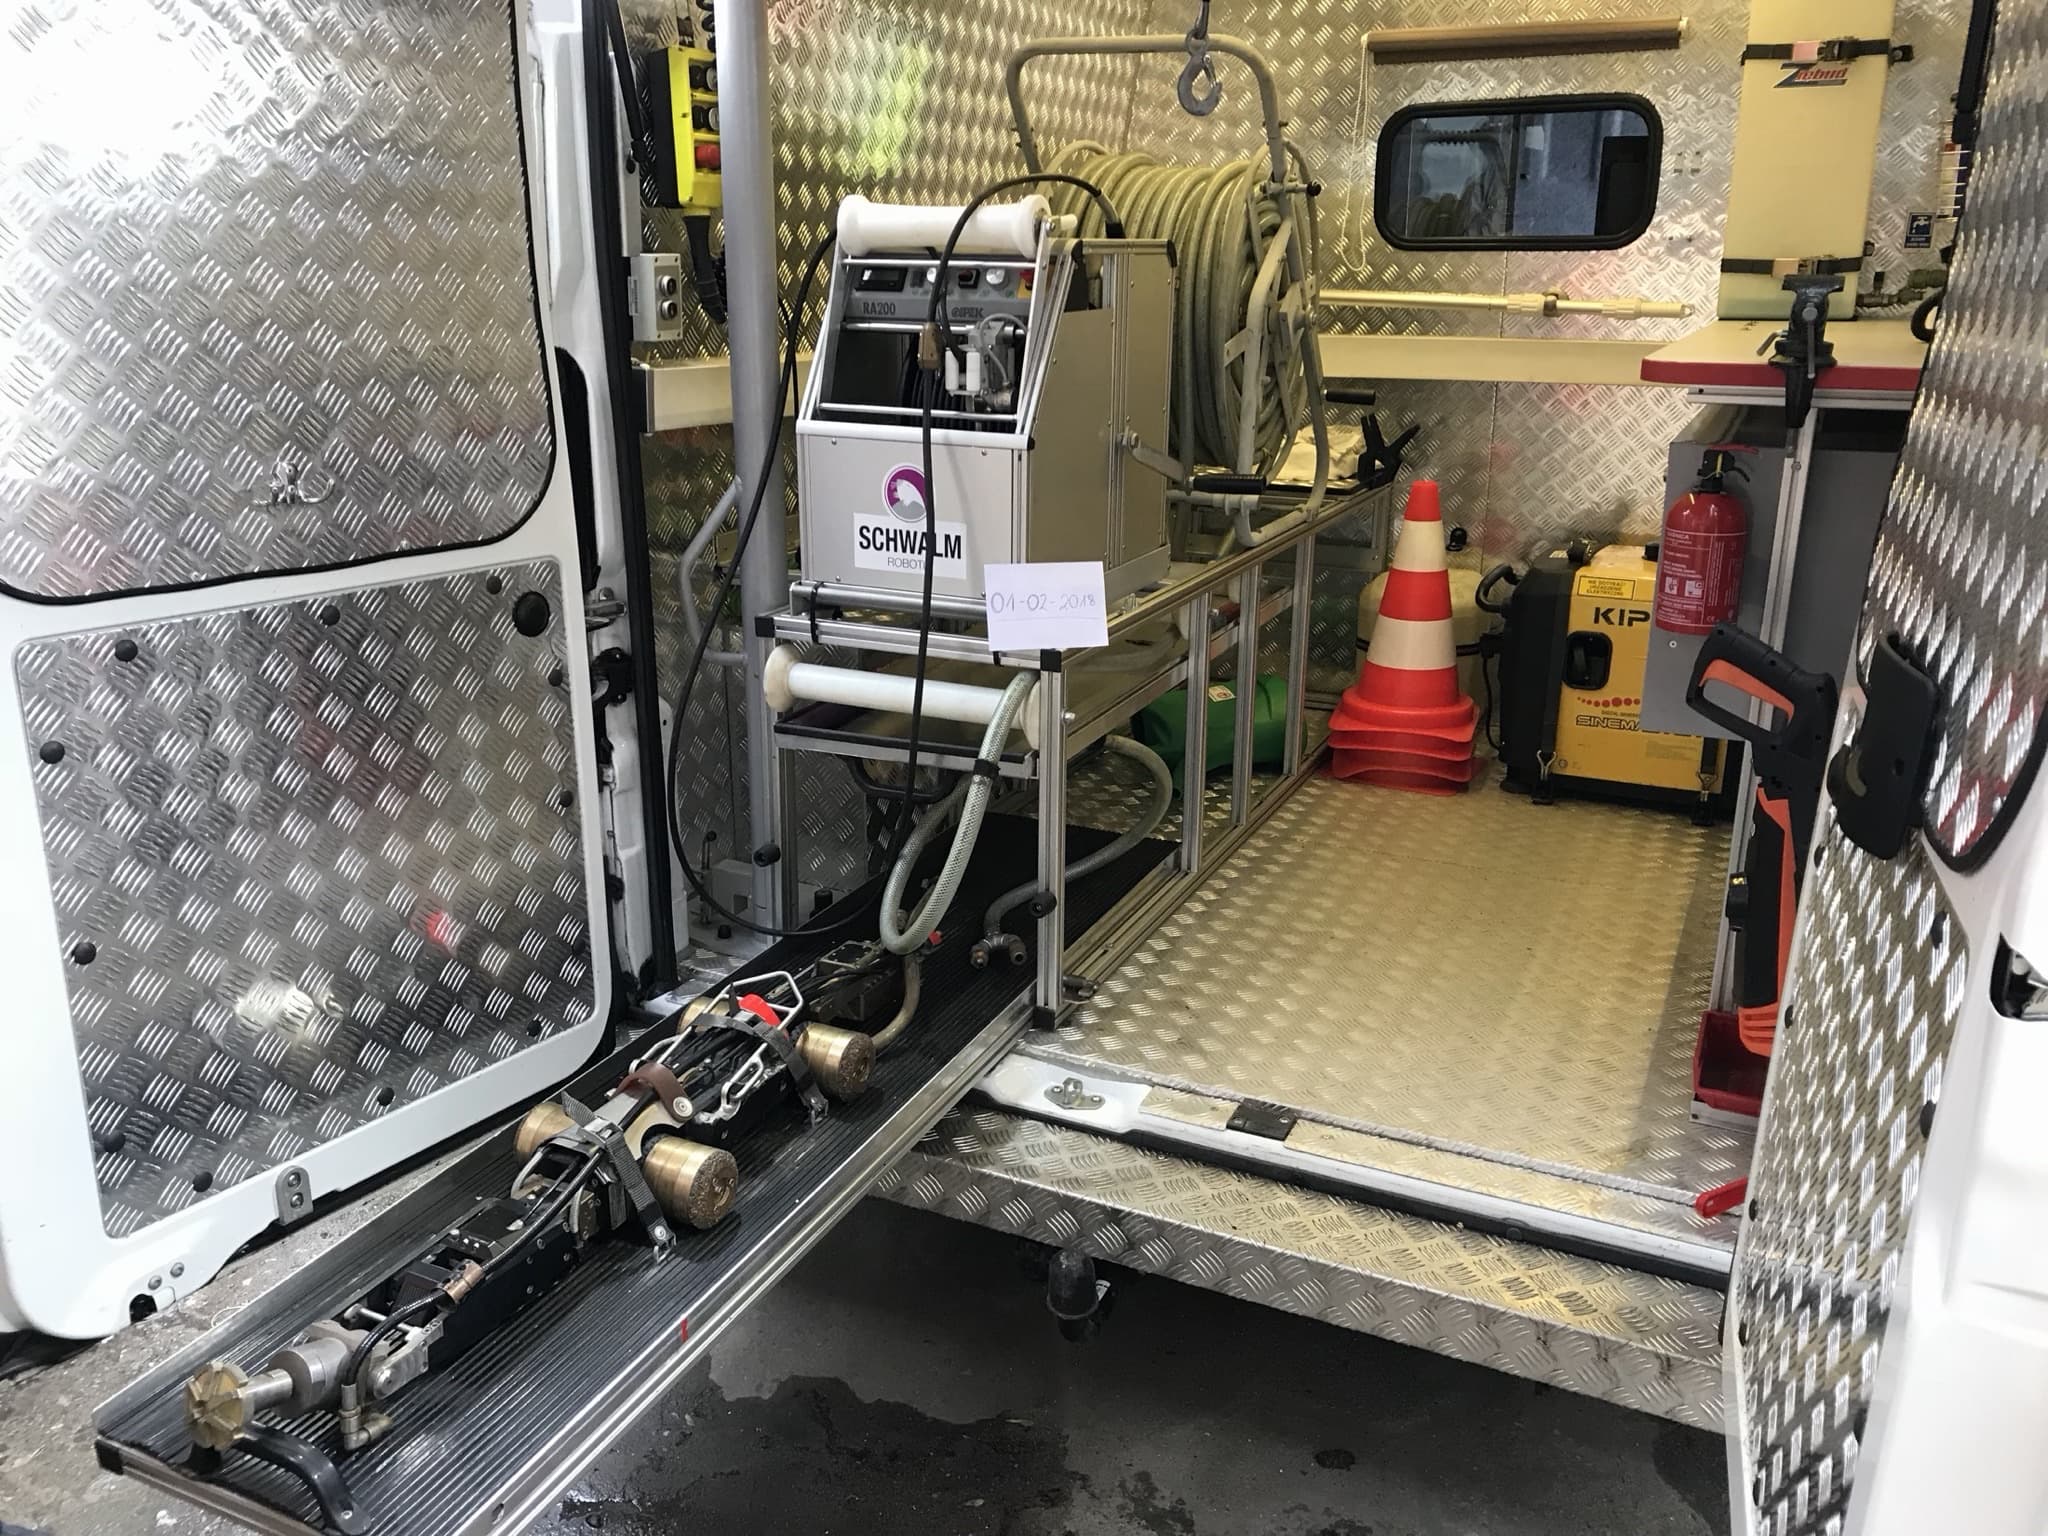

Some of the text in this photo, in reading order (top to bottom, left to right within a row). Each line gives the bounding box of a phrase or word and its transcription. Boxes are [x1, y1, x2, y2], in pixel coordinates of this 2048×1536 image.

[863, 302, 896, 316] RA200
[859, 525, 962, 560] SCHWALM
[887, 556, 927, 571] ROBOTI
[990, 592, 1096, 614] 01-02-2018
[1594, 607, 1650, 627] KIP
[1576, 714, 1640, 732] SINEM
